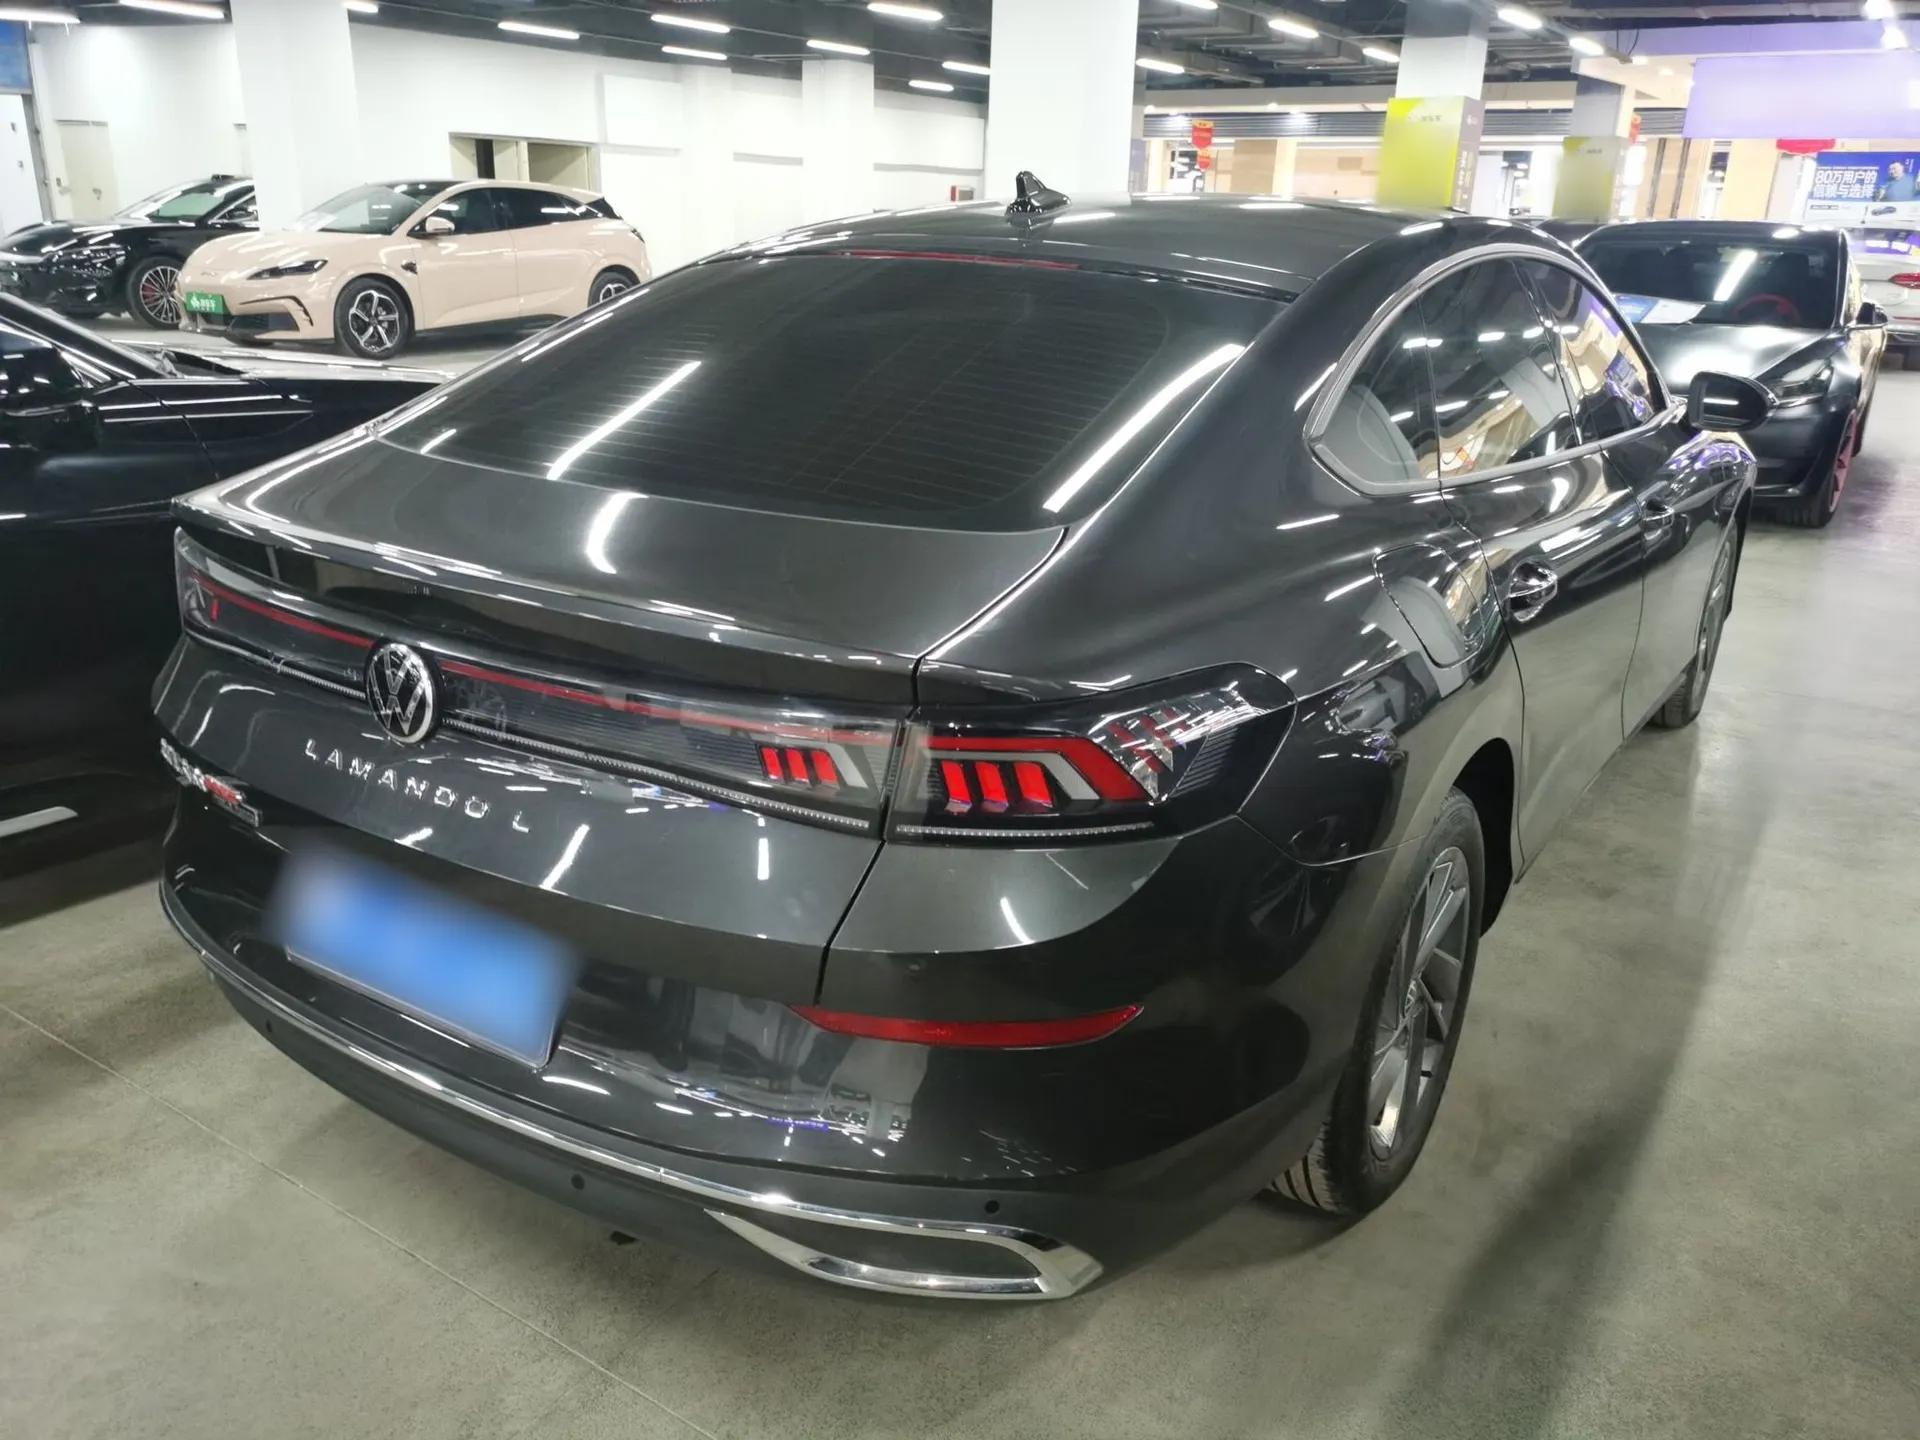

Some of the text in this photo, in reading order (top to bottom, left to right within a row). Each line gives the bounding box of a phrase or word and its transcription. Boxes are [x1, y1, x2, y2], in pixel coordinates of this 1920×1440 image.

[1815, 170, 1878, 184] 80万用户的
[304, 738, 489, 819] LAMANDO
[511, 810, 530, 833] L
